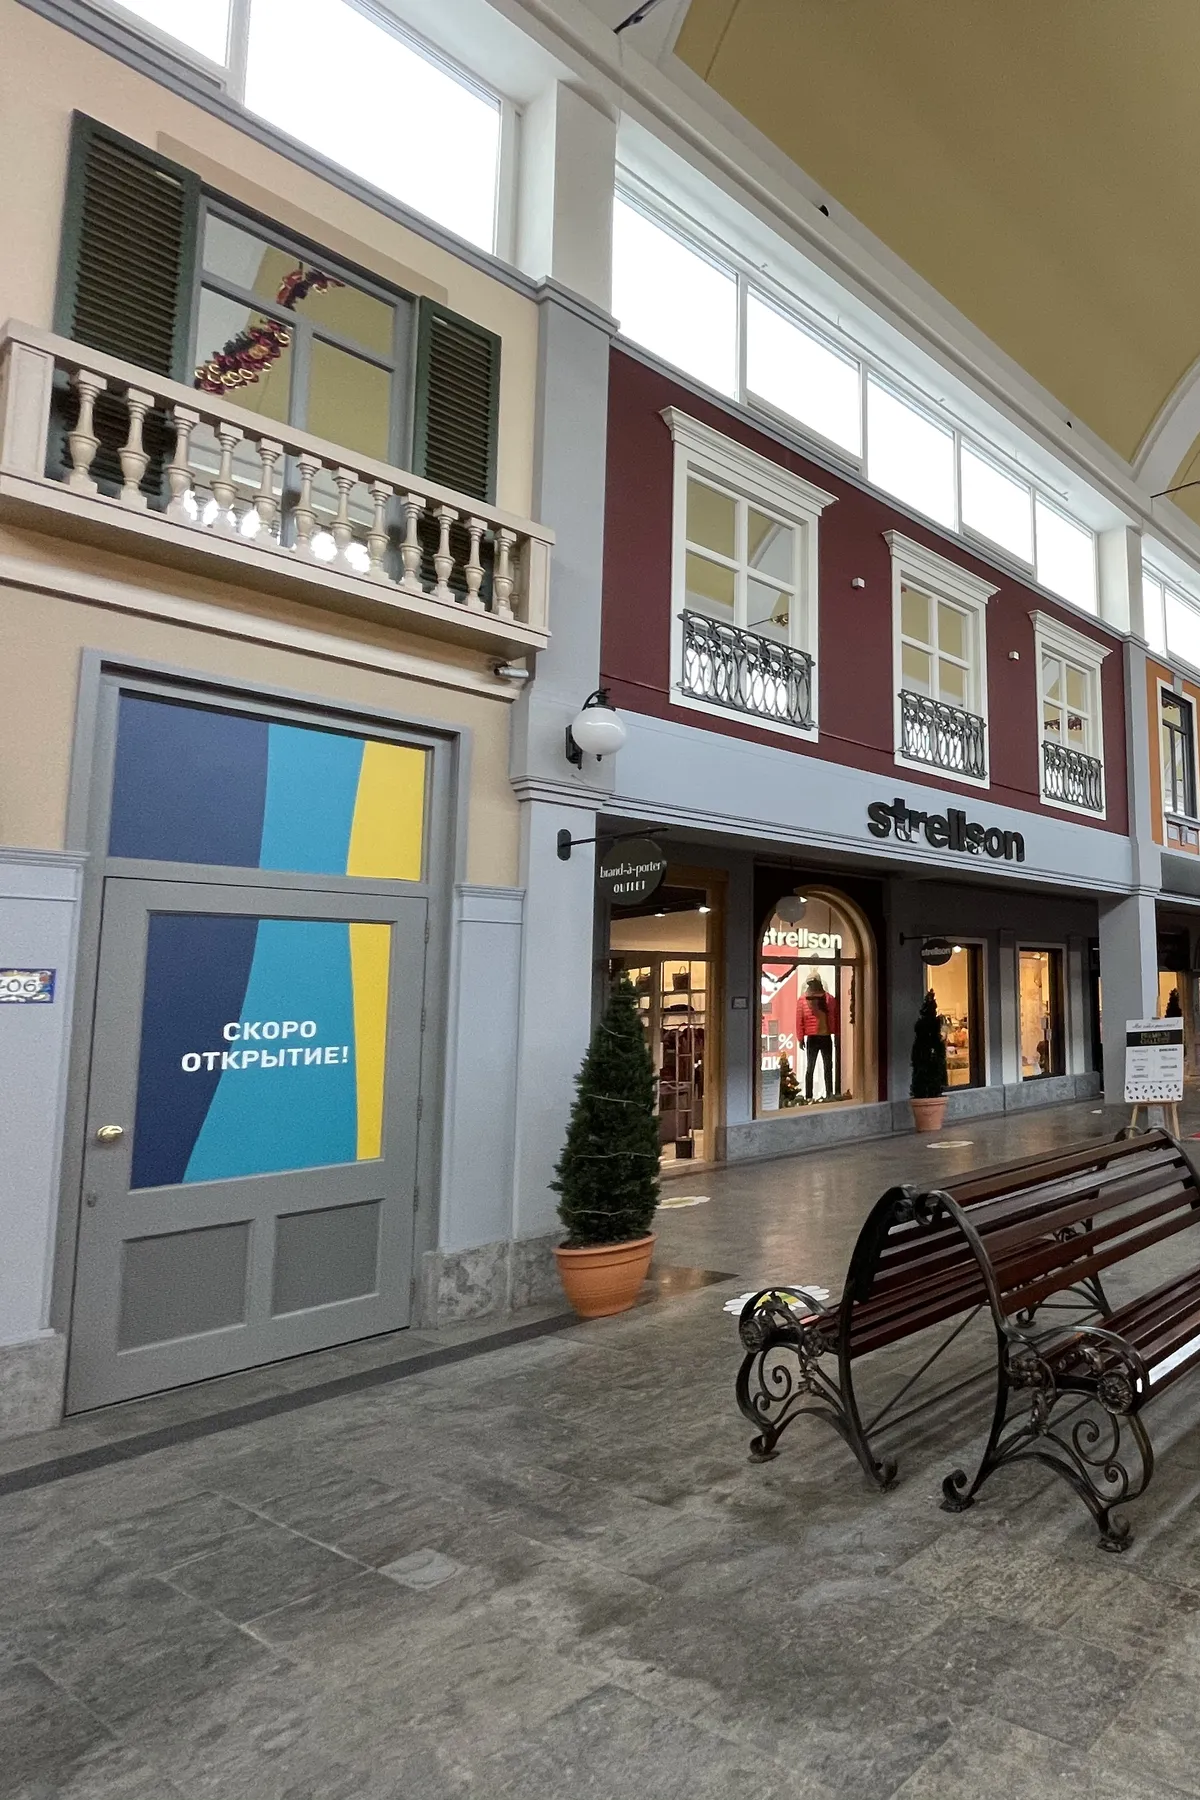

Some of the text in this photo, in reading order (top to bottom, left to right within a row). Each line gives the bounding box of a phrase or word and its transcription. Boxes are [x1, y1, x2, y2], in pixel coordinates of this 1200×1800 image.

[867, 797, 1025, 862] strellson
[613, 880, 645, 894] OUTLET
[762, 927, 842, 949] strellson
[222, 1020, 317, 1041] СКОРО
[181, 1046, 349, 1072] ОТКРЫТИЕ!
